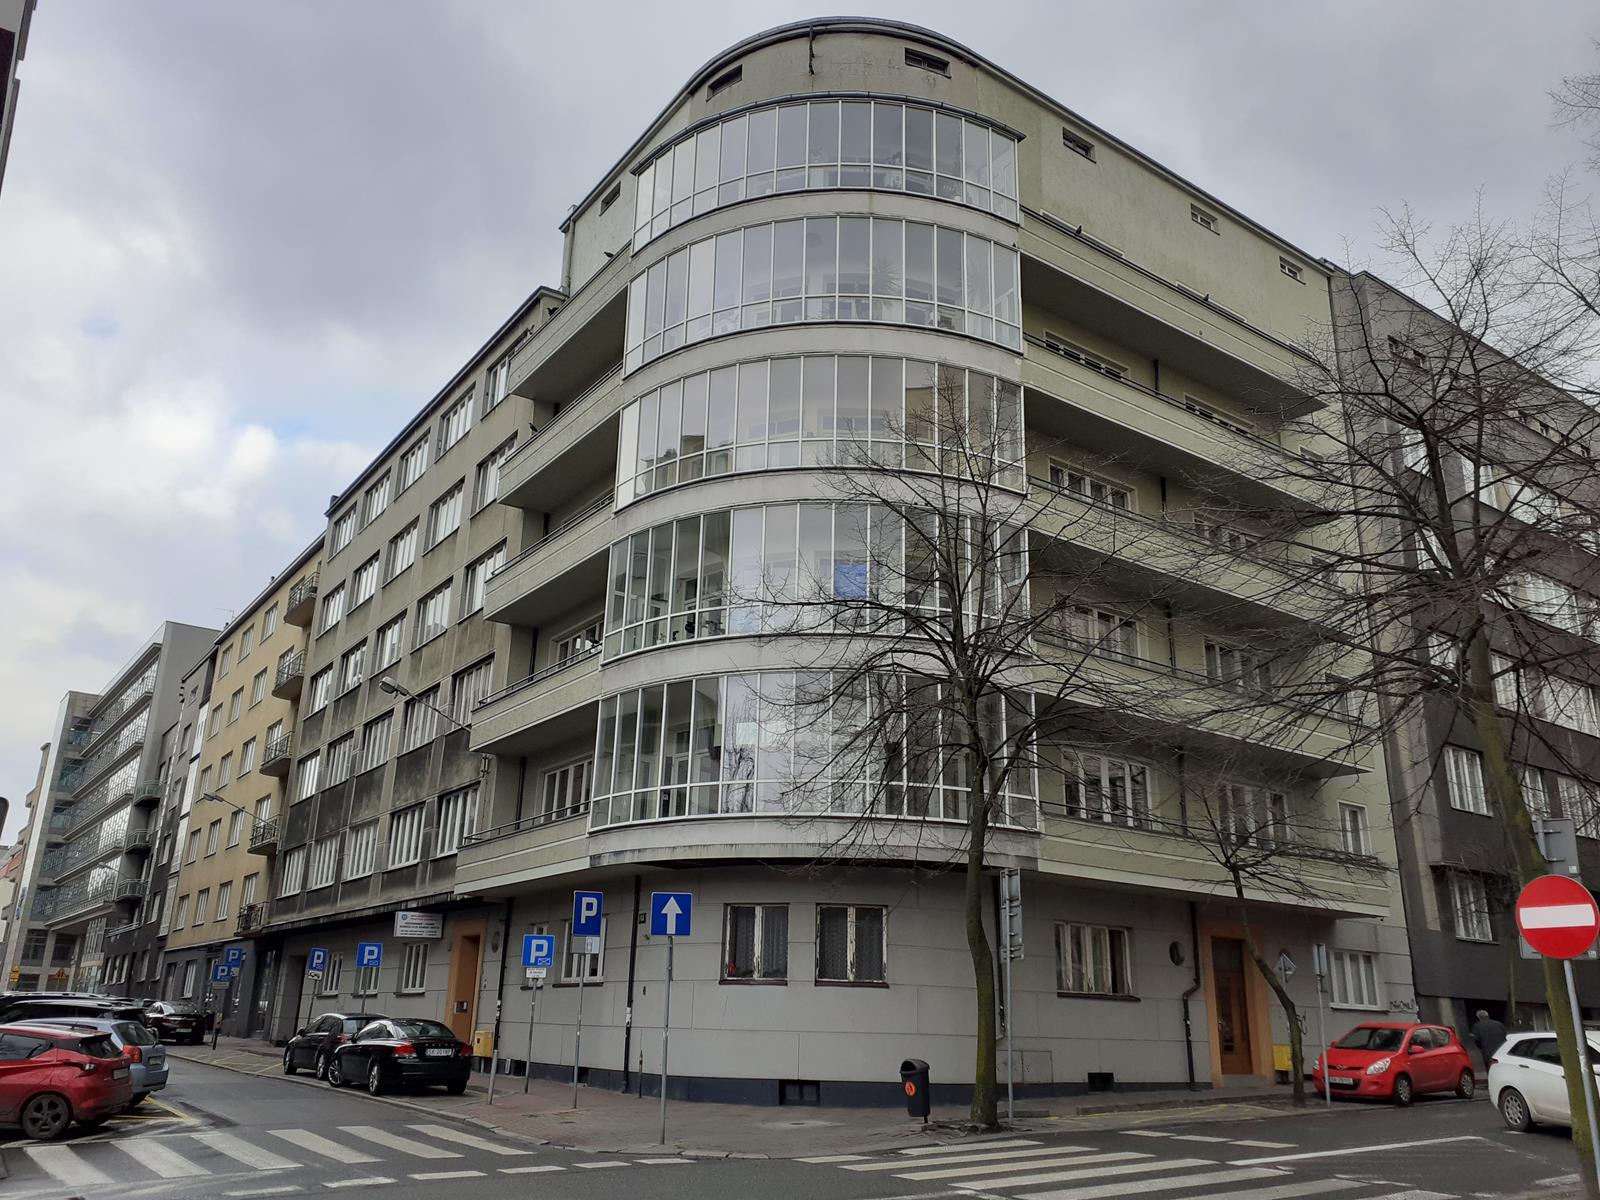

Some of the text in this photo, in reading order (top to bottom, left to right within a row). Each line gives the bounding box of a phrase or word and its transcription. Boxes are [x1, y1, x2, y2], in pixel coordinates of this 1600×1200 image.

[581, 897, 597, 923] P
[228, 950, 238, 963] P
[312, 950, 324, 967] P
[363, 945, 379, 964] P
[531, 940, 548, 963] P
[217, 966, 228, 979] P
